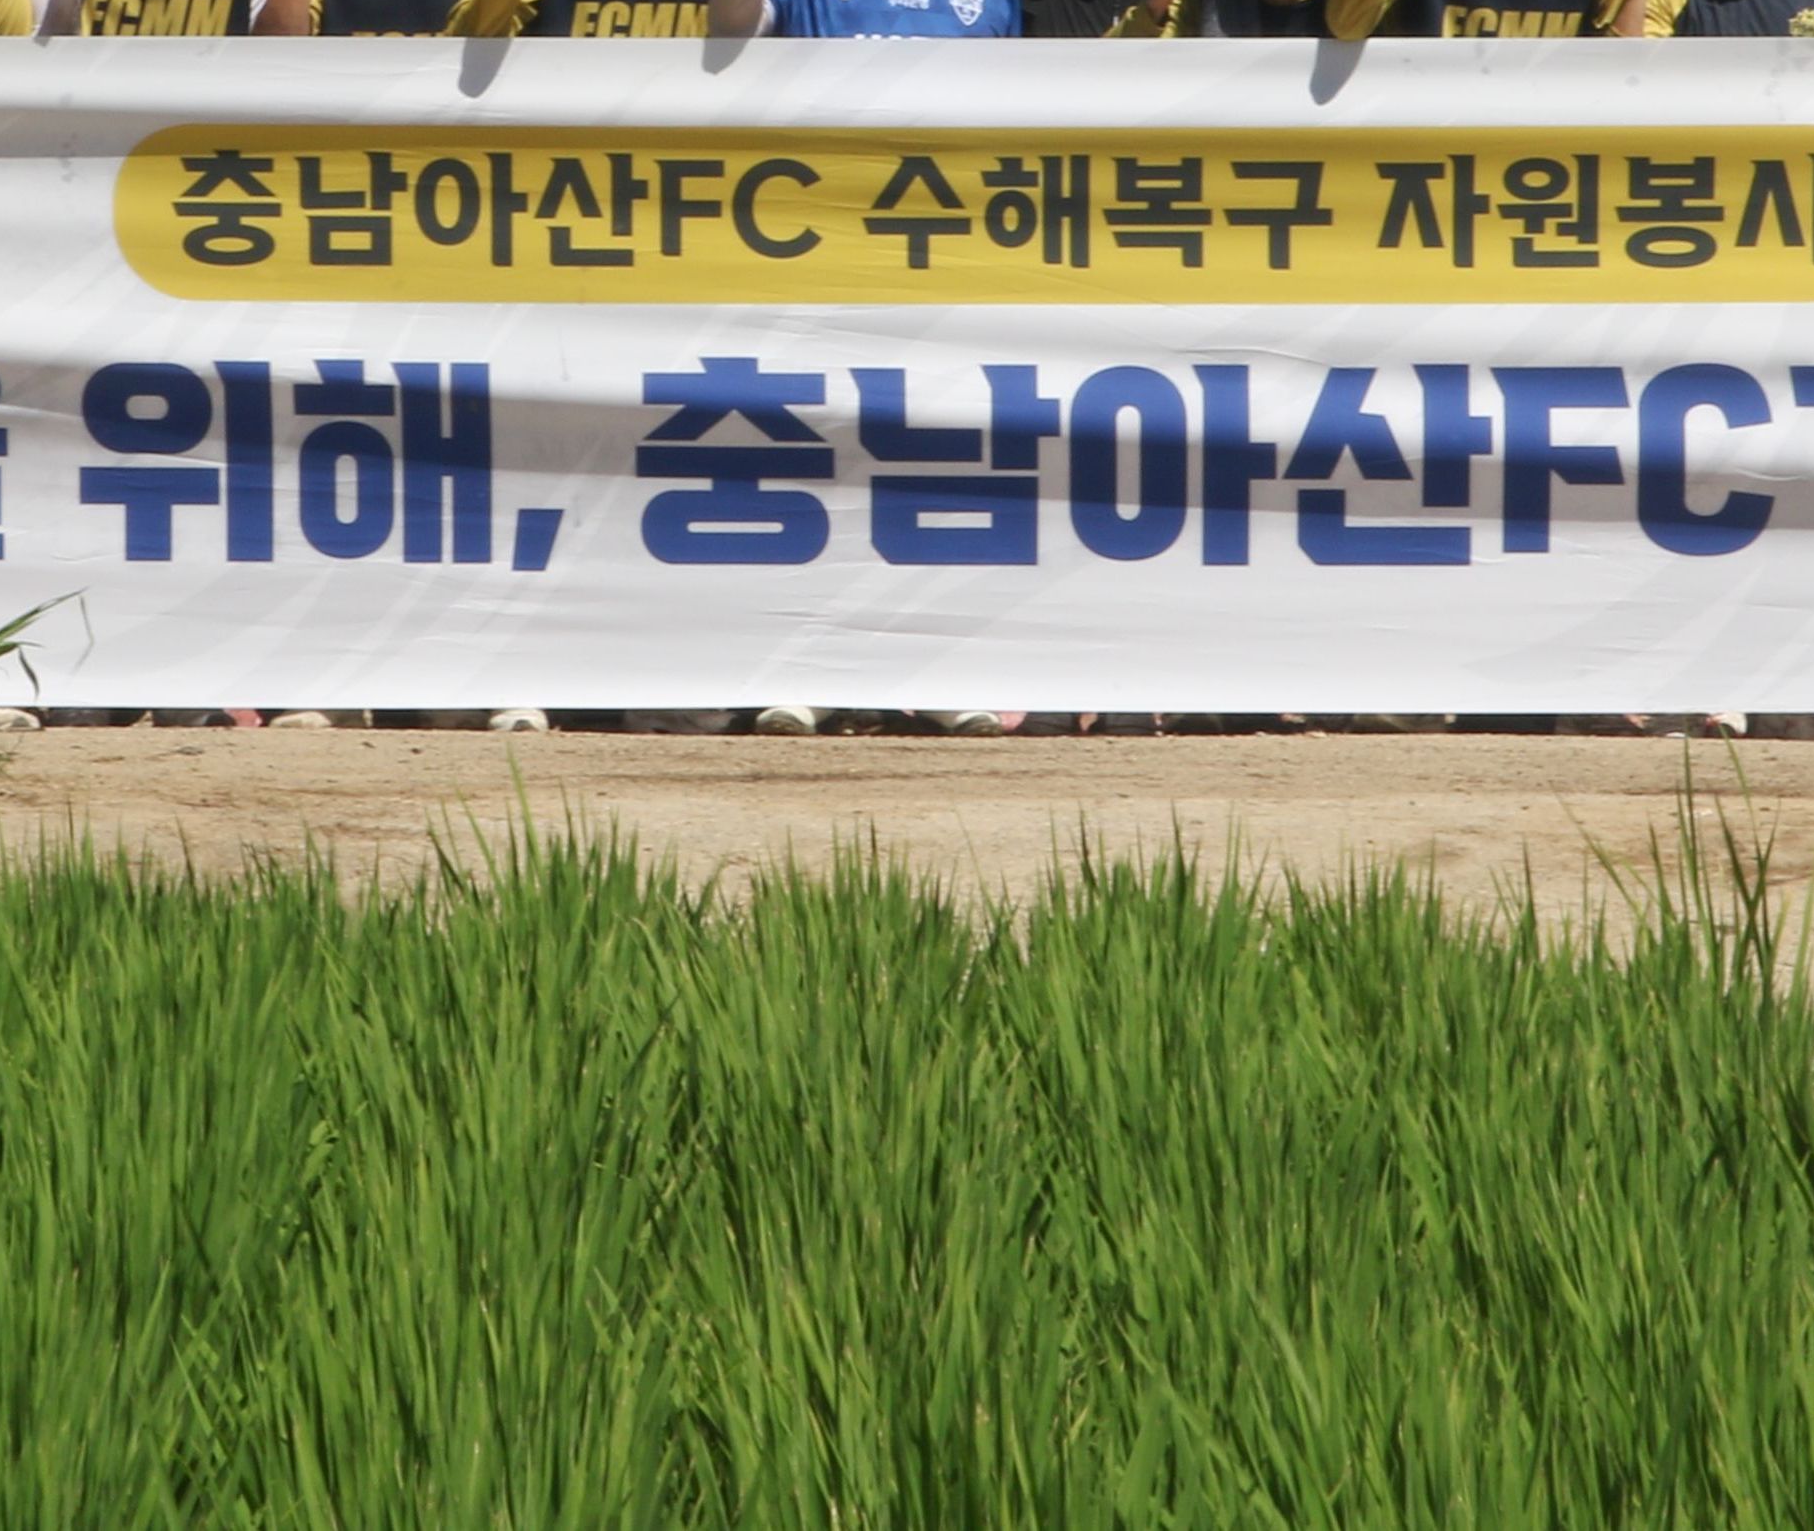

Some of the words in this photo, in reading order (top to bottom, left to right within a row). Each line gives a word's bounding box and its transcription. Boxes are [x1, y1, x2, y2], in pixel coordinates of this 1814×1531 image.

[174, 150, 820, 266] 충남아산FC
[863, 154, 1333, 269] 수해복구
[79, 357, 561, 571] 위해,
